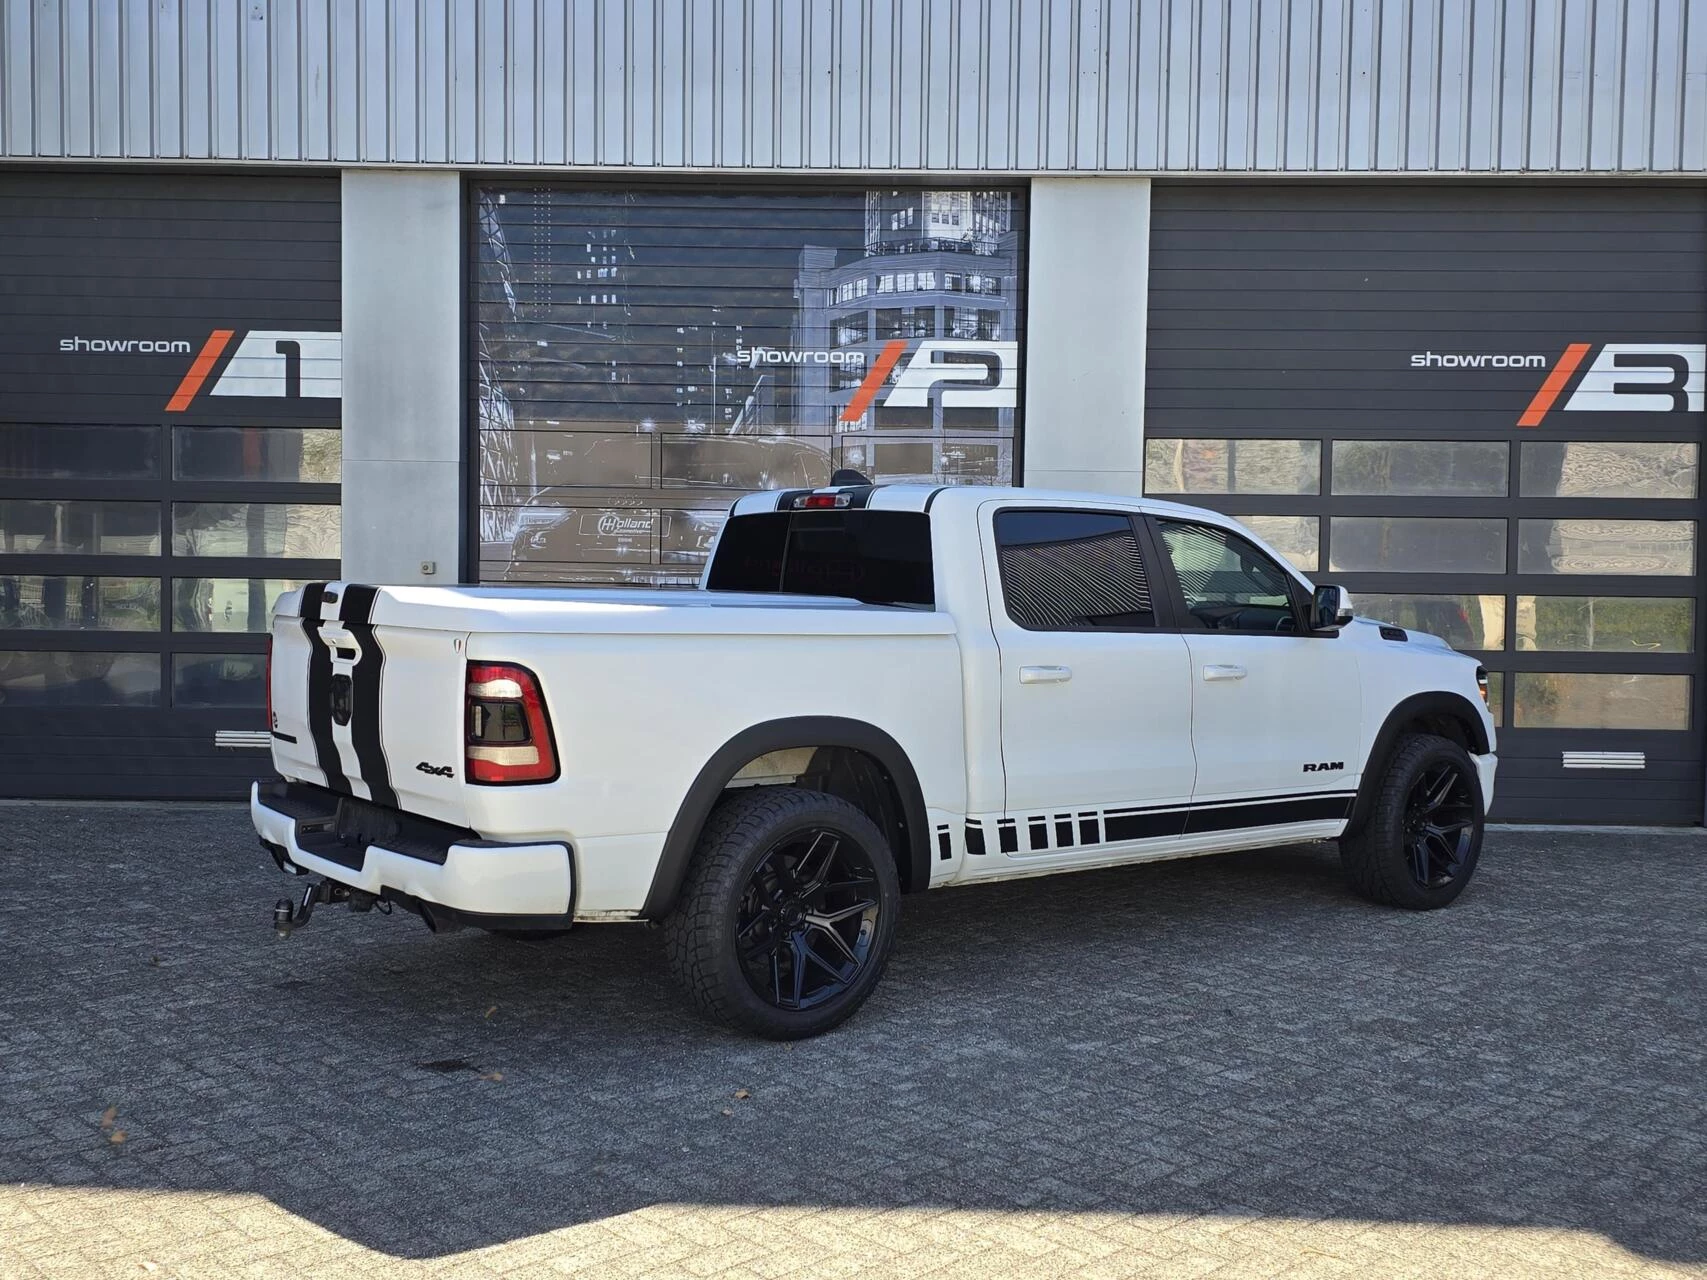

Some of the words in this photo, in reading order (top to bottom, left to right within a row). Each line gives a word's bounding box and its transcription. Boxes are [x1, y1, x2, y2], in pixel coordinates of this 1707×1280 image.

[60, 336, 191, 352] showroom
[737, 346, 865, 364] showroom
[1410, 351, 1546, 367] showroom
[599, 516, 655, 532] Holland
[415, 761, 455, 778] 4x4
[1302, 761, 1345, 773] RAM
